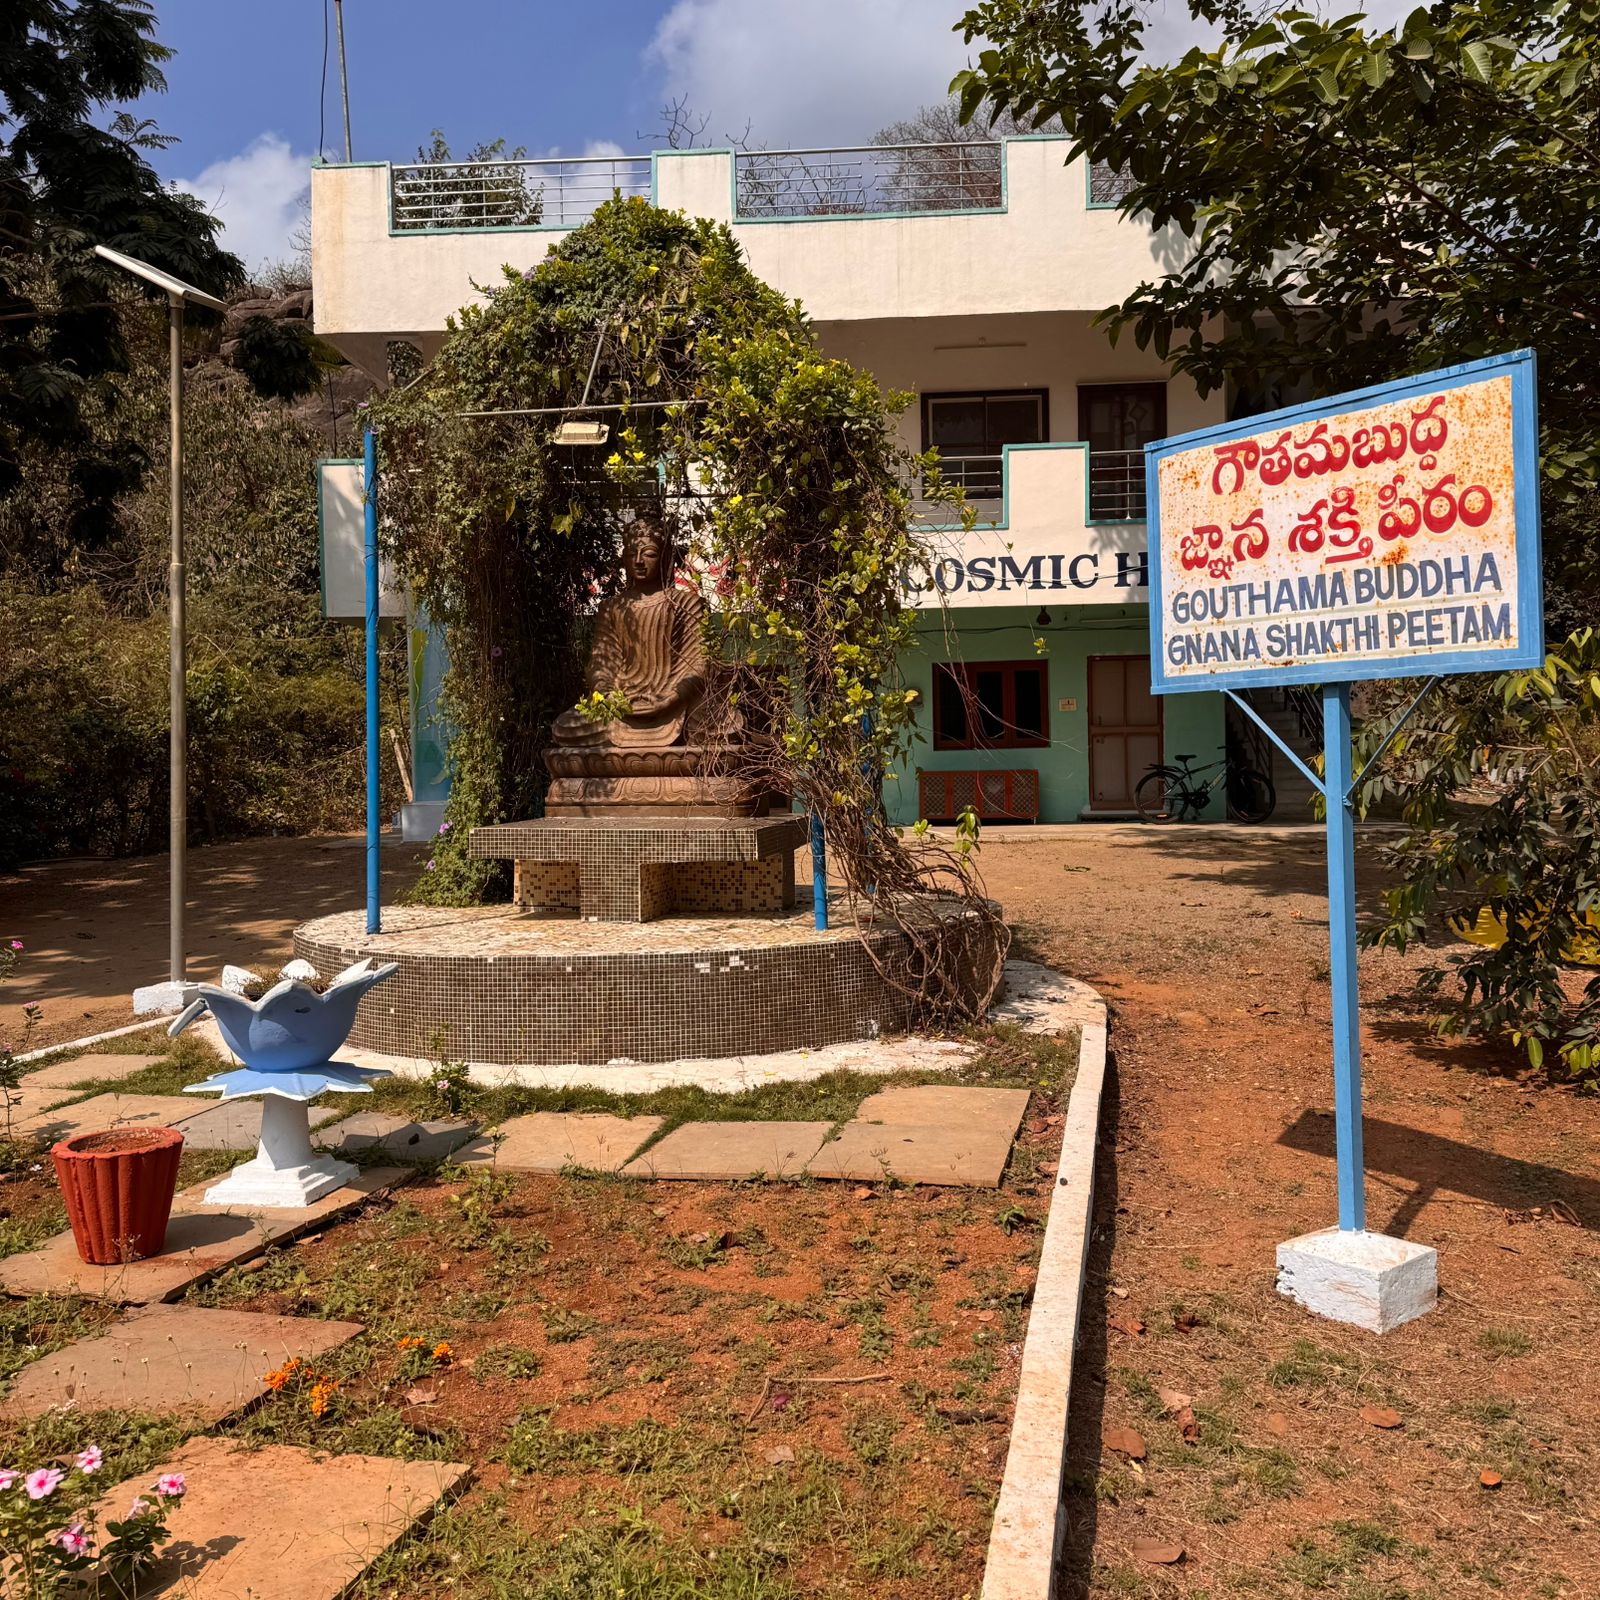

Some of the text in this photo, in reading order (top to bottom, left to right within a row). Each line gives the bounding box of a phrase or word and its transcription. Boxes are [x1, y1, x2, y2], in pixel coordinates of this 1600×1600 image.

[1287, 486, 1374, 564] శక్తి
[1172, 552, 1503, 624] GOUTHAMA BUDDHA
[1167, 602, 1511, 666] GNANA SHAKTHI PEETAM
